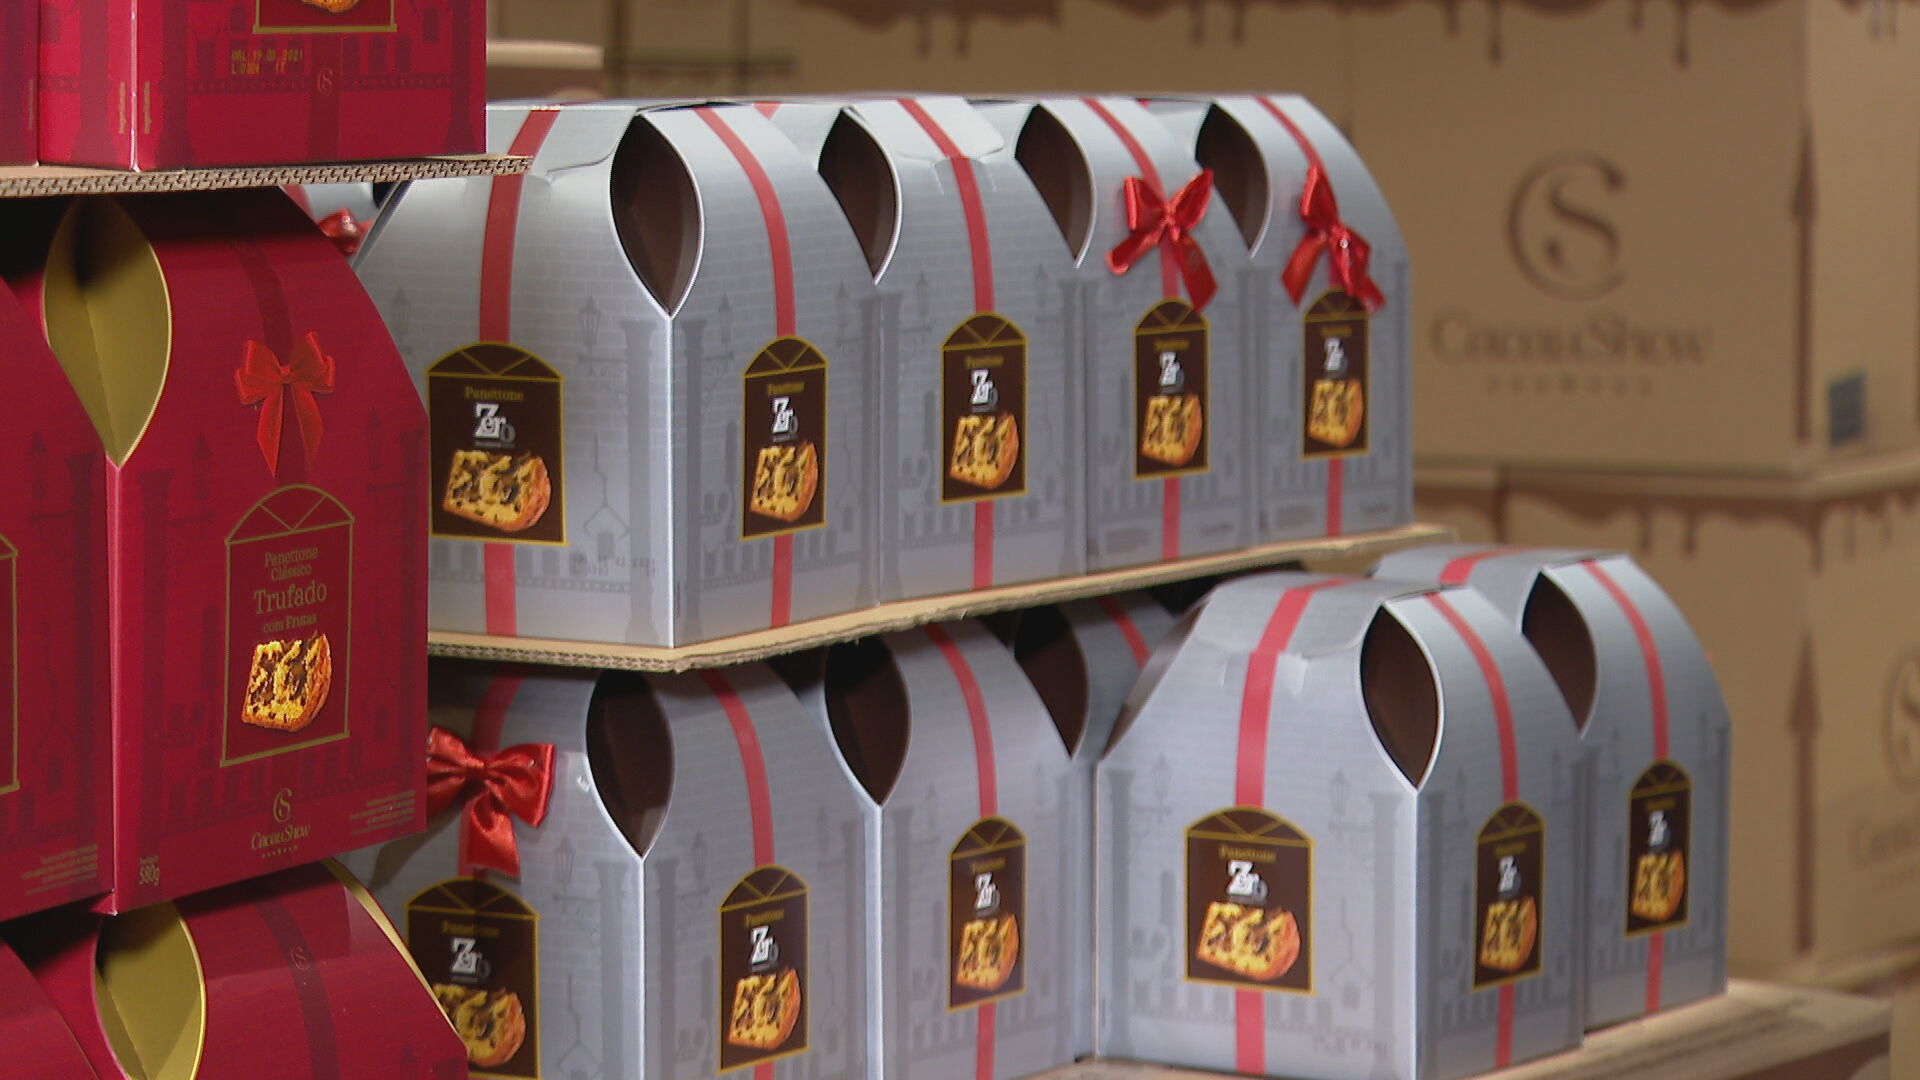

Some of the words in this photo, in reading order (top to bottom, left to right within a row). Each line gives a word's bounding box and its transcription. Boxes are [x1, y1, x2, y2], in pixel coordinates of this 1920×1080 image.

[474, 403, 516, 443] Zero
[253, 579, 328, 615] Trufado
[139, 864, 160, 886] 580g
